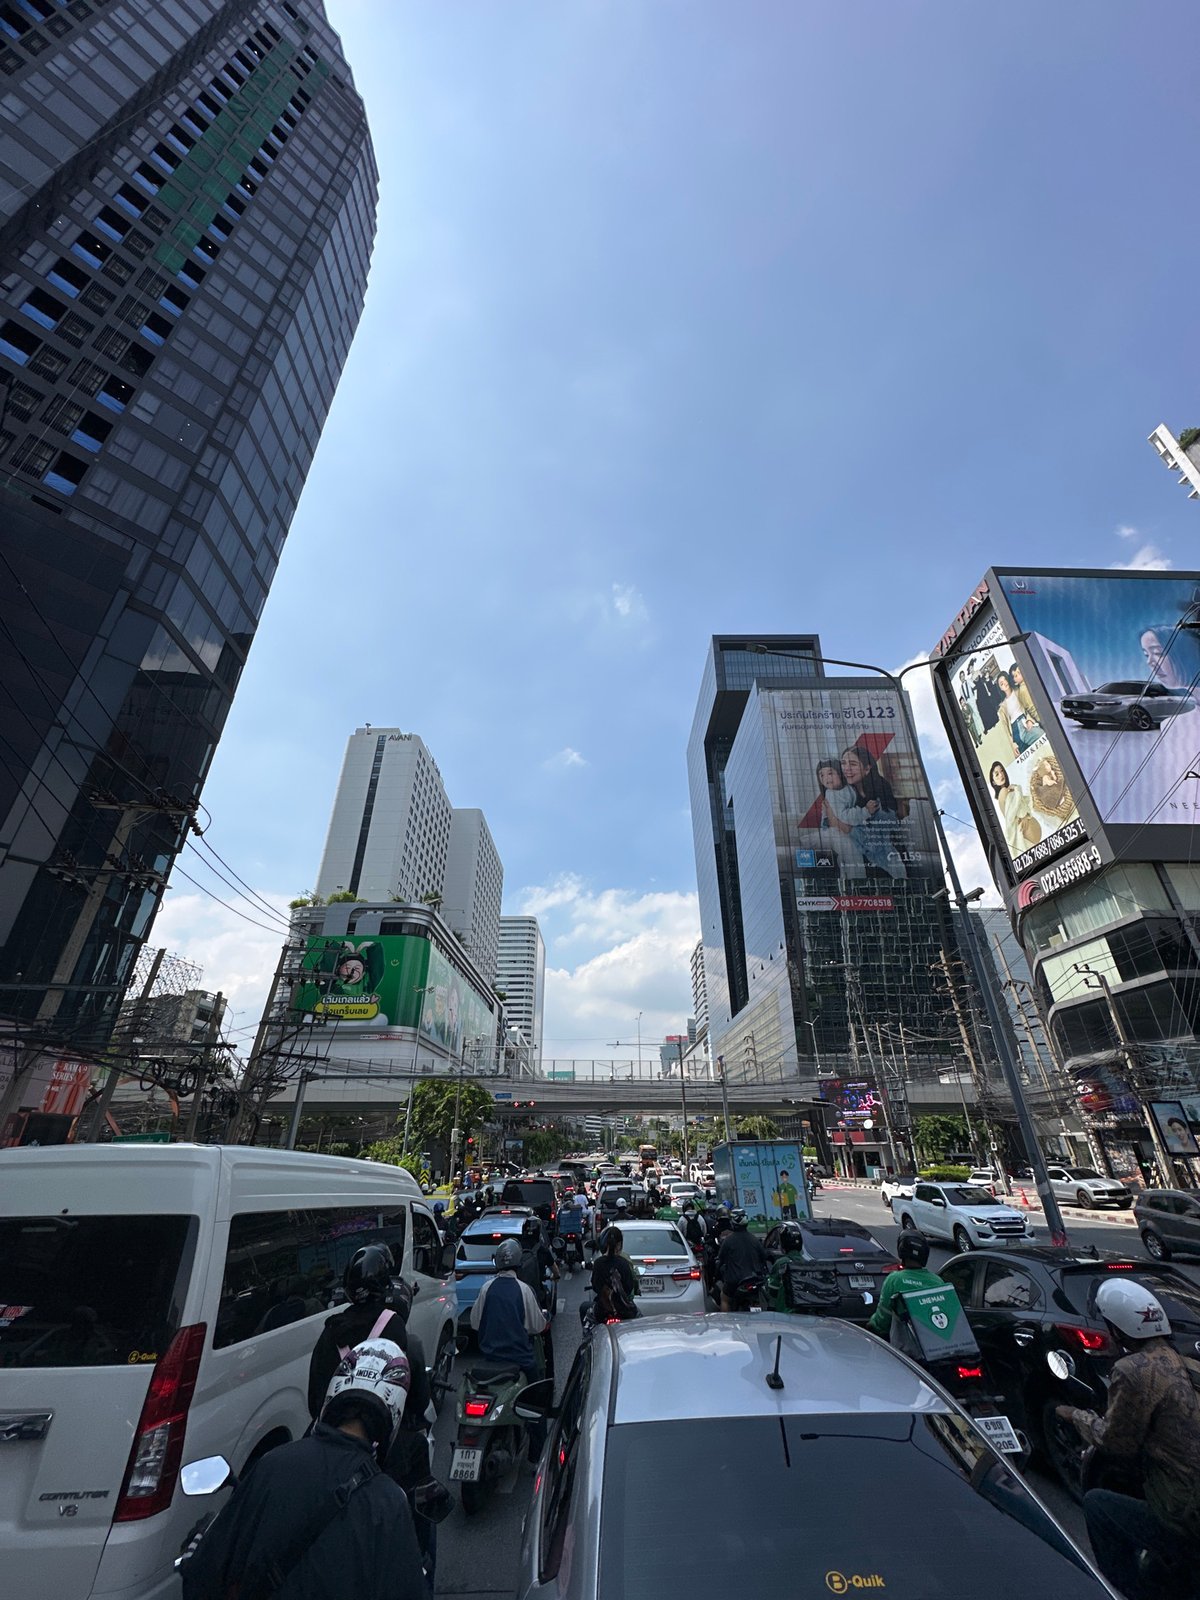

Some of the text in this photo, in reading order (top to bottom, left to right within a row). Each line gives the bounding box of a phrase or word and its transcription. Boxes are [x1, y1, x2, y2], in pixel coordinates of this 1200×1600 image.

[935, 624, 957, 656] YIN
[957, 579, 990, 626] TIAN
[388, 733, 413, 741] AVANI
[1020, 750, 1030, 763] KID
[1012, 859, 1022, 873] 02
[1020, 851, 1033, 869] 126
[1063, 825, 1079, 843] 325
[1040, 845, 1102, 894] 022456988-9
[356, 1369, 378, 1380] INDEX
[39, 1490, 110, 1501] COMMUTER
